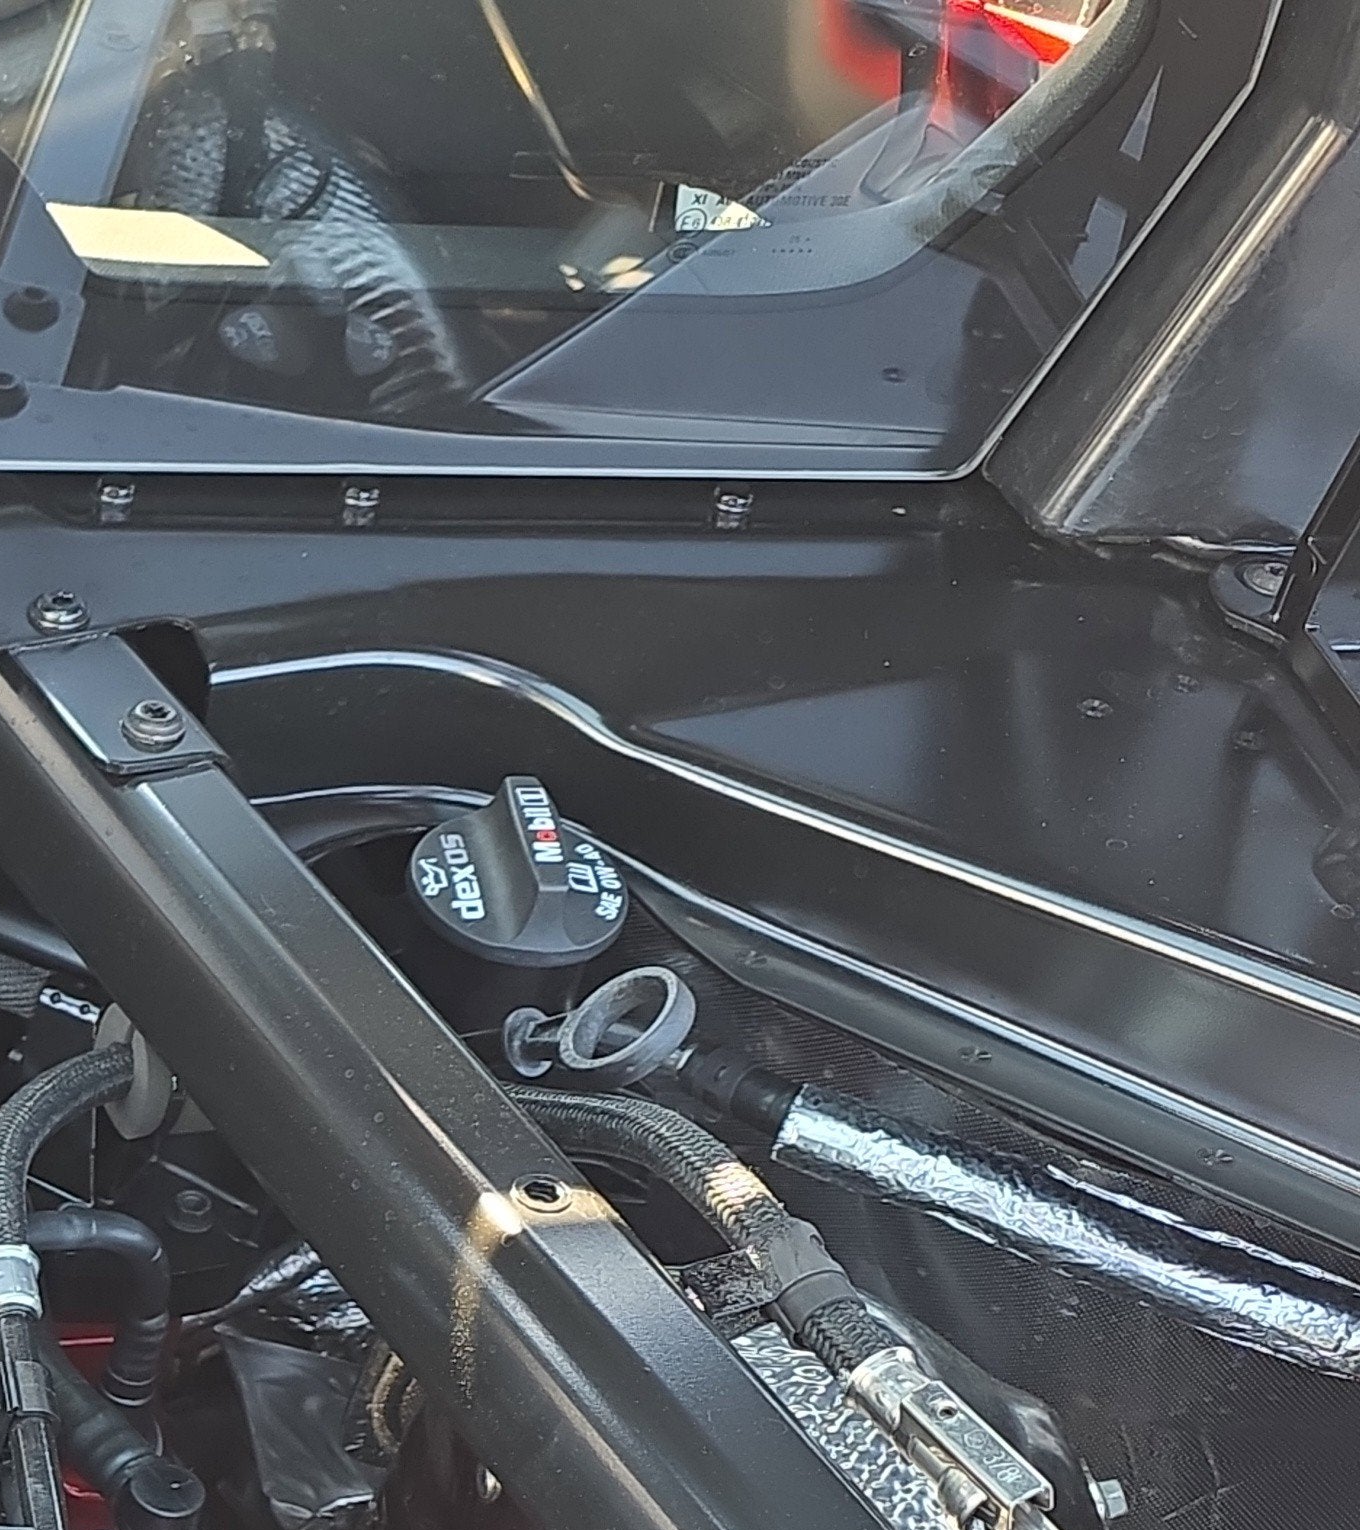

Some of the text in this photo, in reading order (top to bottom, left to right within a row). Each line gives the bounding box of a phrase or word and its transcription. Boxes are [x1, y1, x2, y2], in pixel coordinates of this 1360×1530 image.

[523, 806, 564, 863] Mobil
[439, 833, 486, 921] dexos
[574, 842, 623, 921] SAE 0W-40
